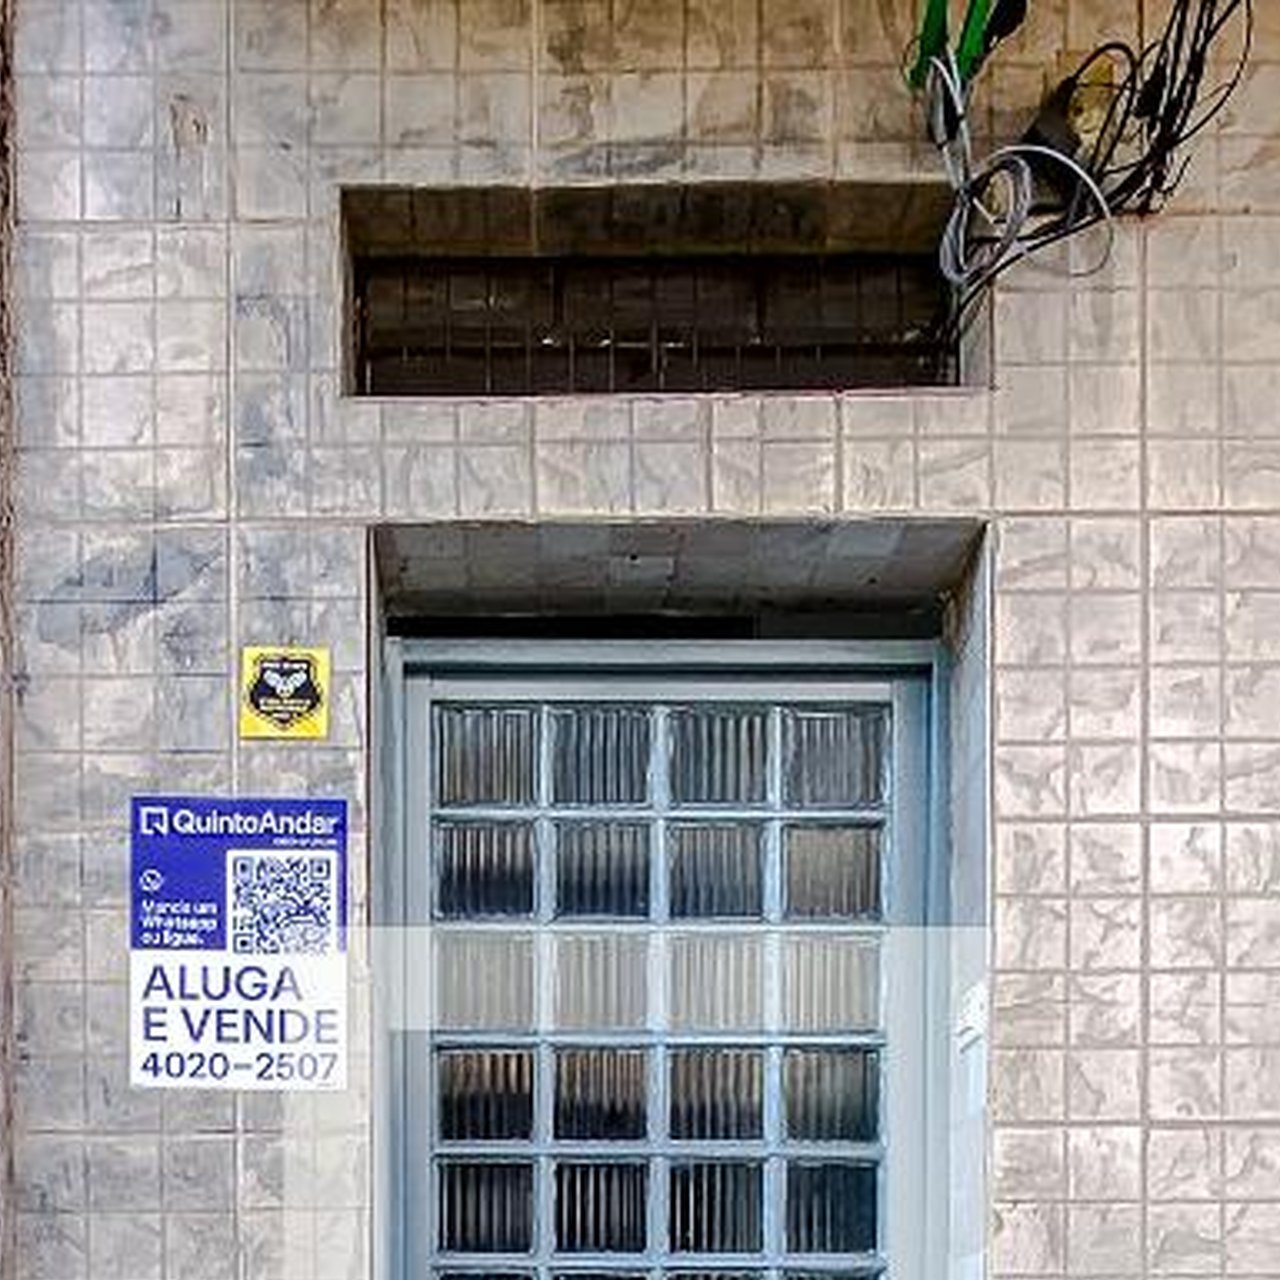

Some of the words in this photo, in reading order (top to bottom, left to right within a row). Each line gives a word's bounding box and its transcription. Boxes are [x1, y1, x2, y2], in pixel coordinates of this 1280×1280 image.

[172, 809, 340, 835] QuintoAndar
[142, 964, 303, 1001] ALUGA
[143, 1006, 167, 1042] E
[180, 1006, 338, 1044] VENDE
[140, 1051, 338, 1081] 4020-2507
